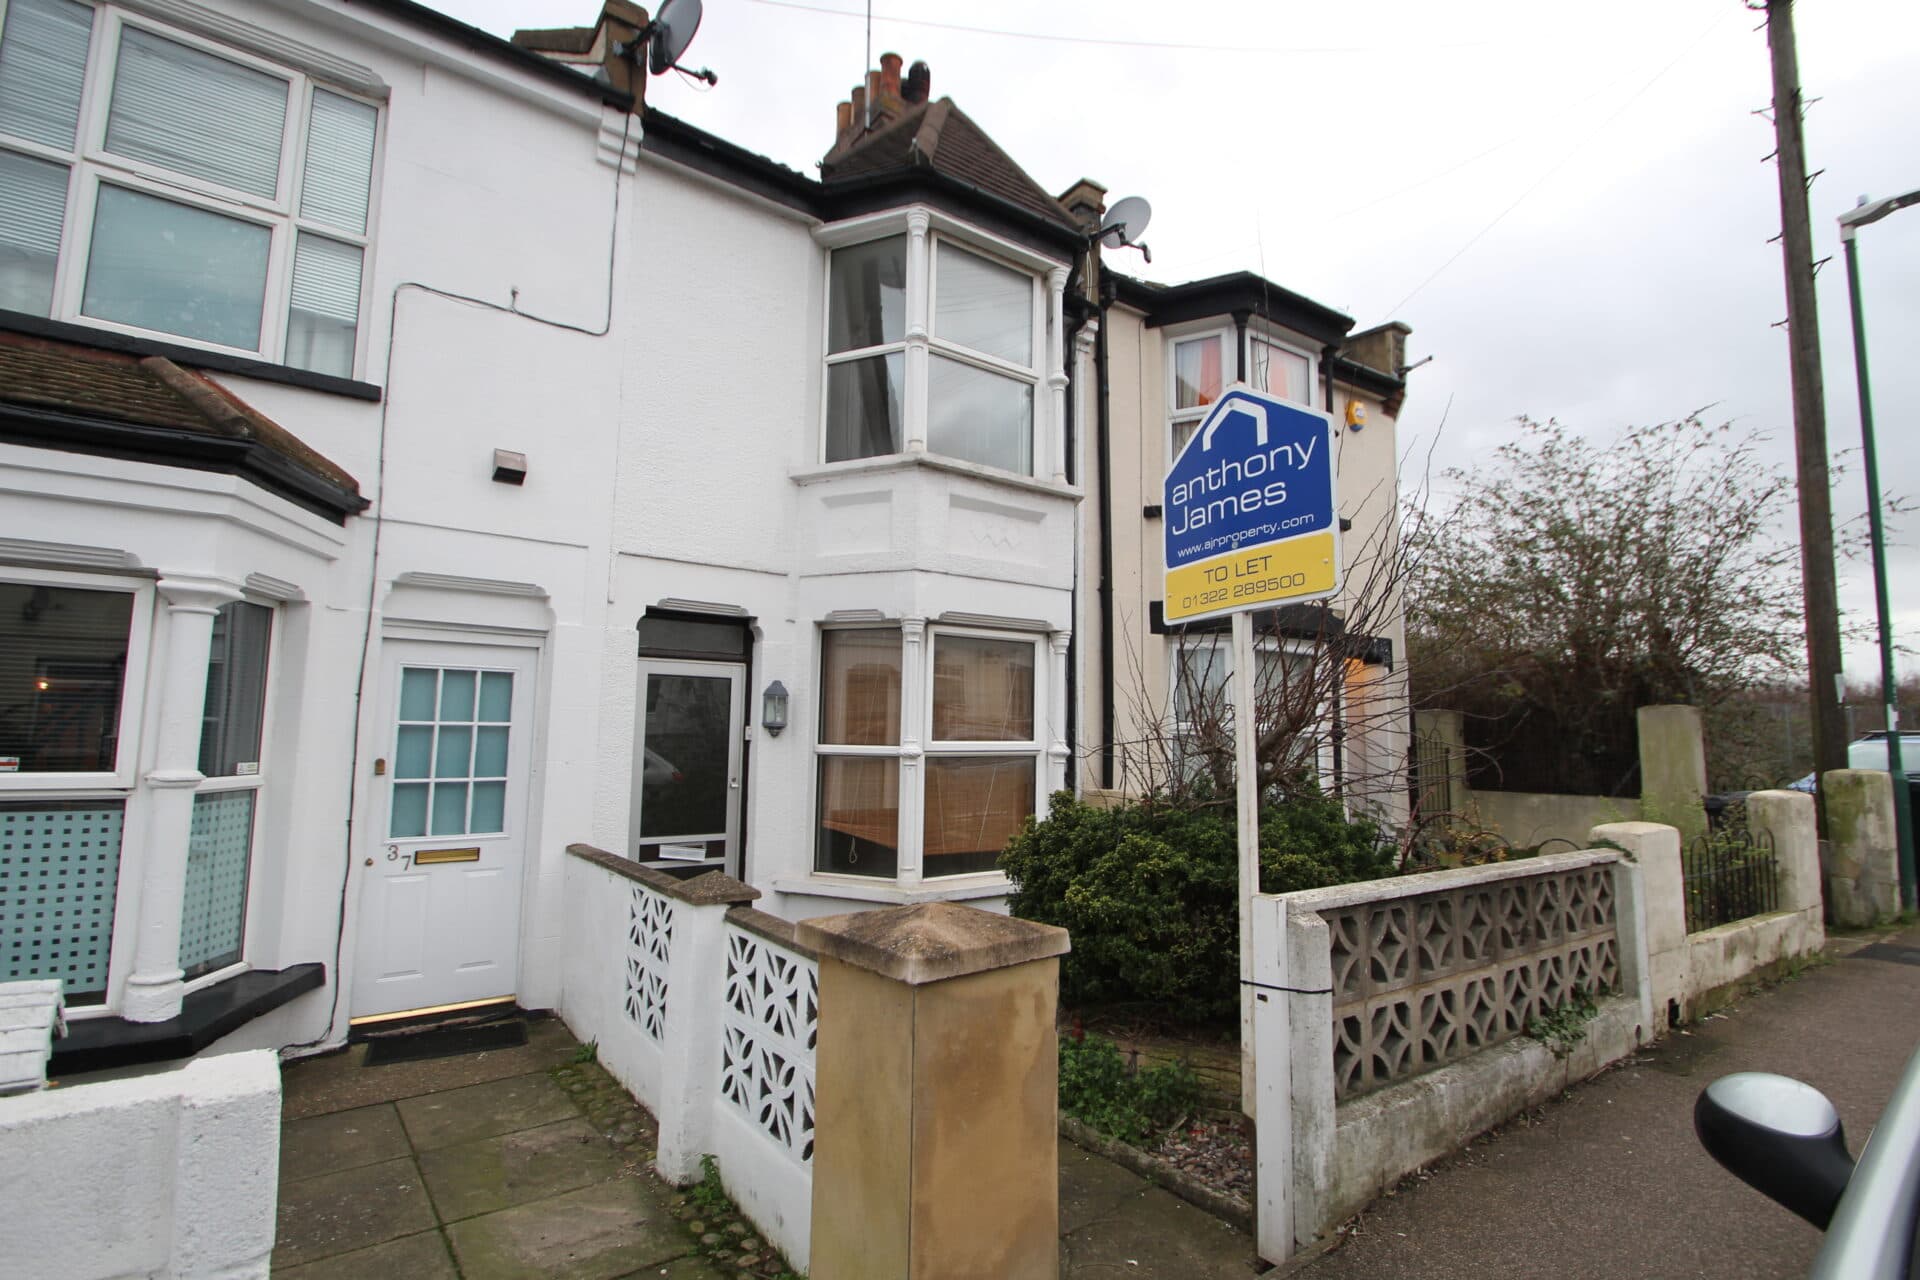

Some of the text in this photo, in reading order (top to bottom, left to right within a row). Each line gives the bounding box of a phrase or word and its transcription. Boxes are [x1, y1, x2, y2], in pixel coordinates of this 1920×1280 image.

[1172, 435, 1317, 505] anthony
[1172, 481, 1287, 536] James
[1177, 512, 1314, 558] www.ajrproperty.com
[1182, 572, 1305, 609] 01322 289500
[1203, 555, 1272, 585] TO LET
